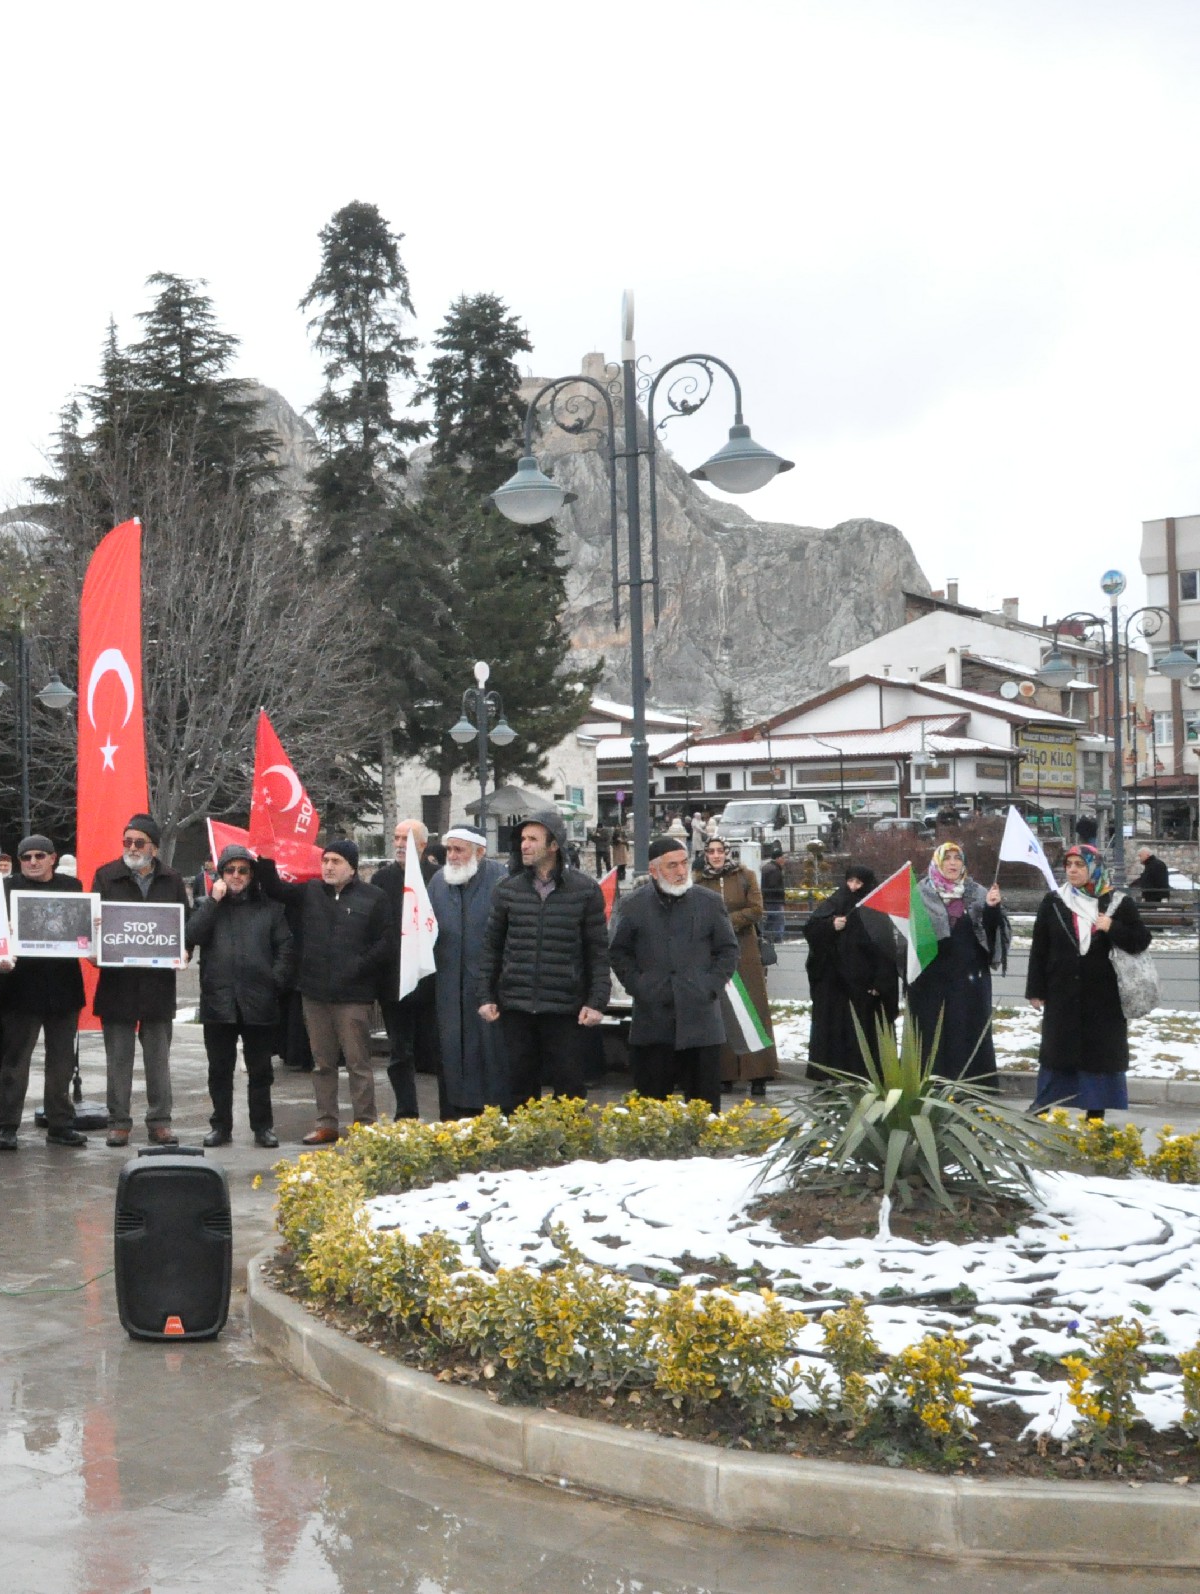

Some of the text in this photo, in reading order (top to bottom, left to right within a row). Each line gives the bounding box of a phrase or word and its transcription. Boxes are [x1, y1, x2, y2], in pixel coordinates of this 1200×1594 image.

[1050, 748, 1072, 767] KİLO
[123, 921, 158, 934] STOP
[103, 933, 178, 946] GENOCIDE
